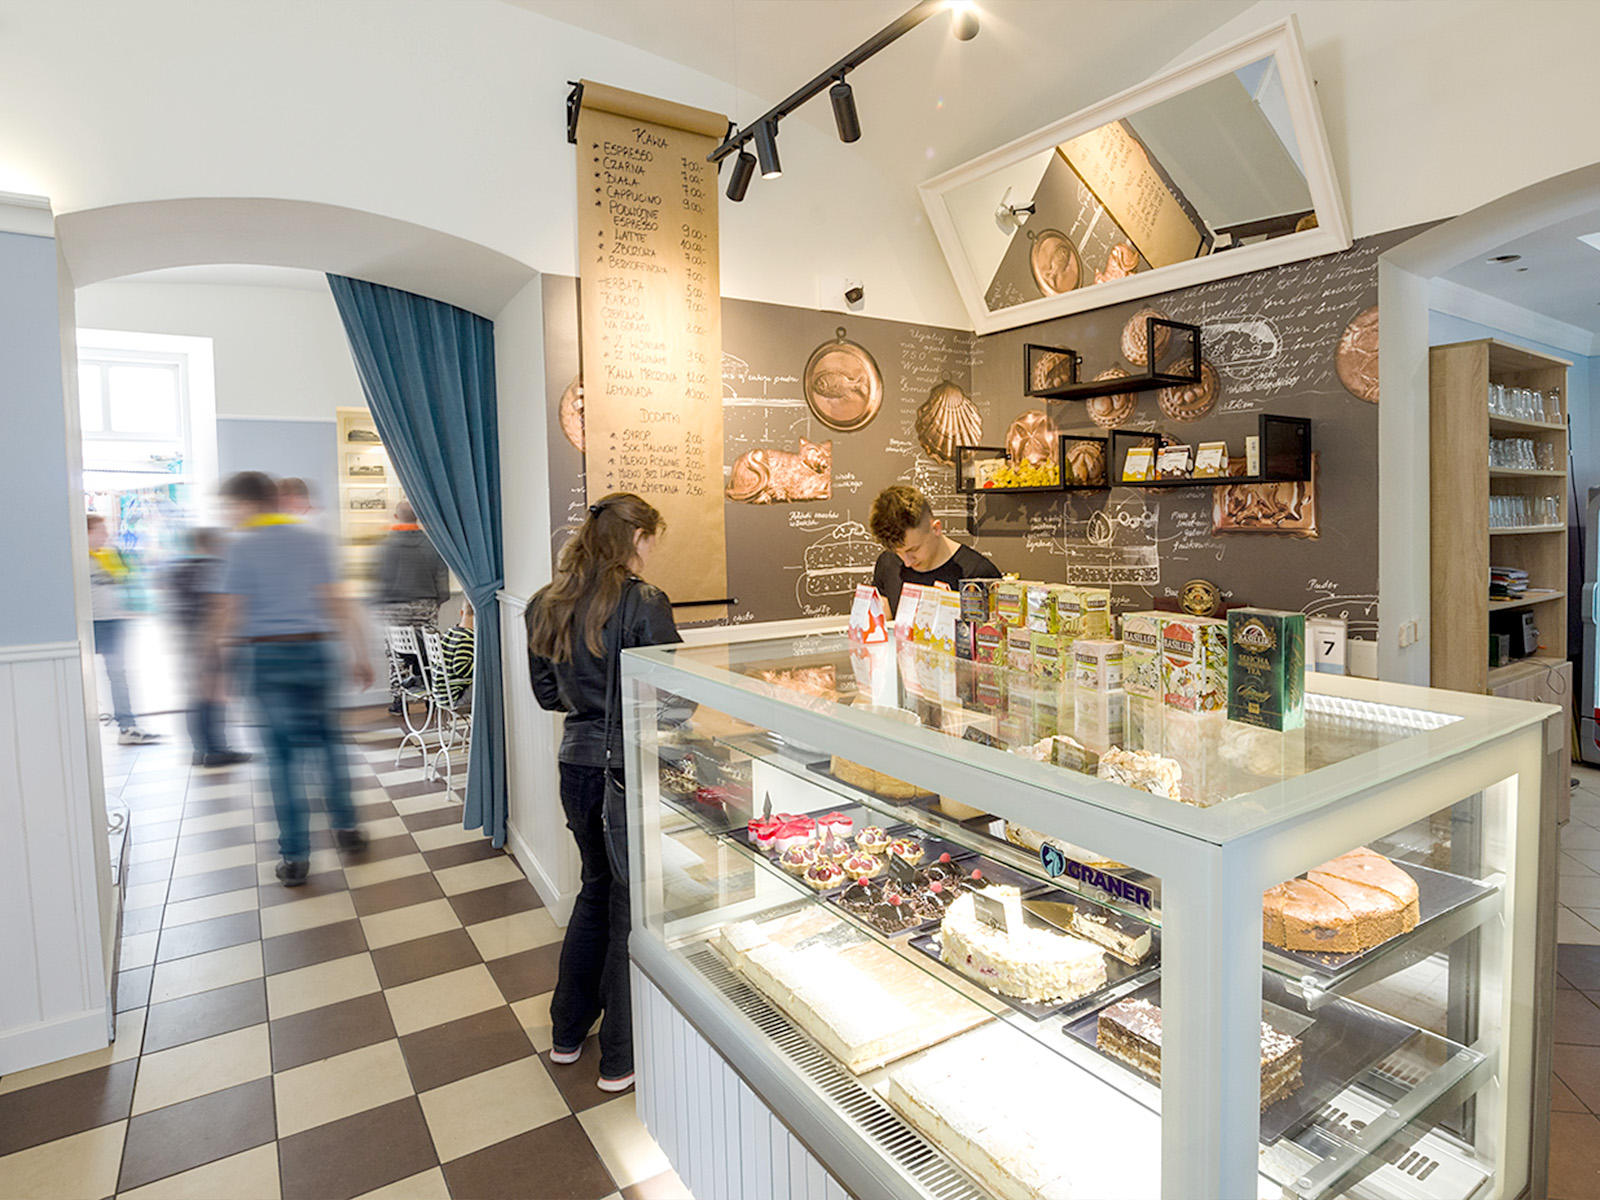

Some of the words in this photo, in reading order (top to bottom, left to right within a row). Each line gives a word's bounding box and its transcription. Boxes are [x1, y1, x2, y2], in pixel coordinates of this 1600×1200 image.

[632, 128, 669, 149] KAWA
[603, 141, 654, 162] ESPRESSO
[602, 157, 646, 176] CZARNA
[613, 215, 659, 231] ESPRESSO
[614, 228, 647, 243] LATTE
[622, 428, 651, 441] SYROP
[1323, 640, 1336, 656] 7
[1067, 860, 1152, 911] GRANER
